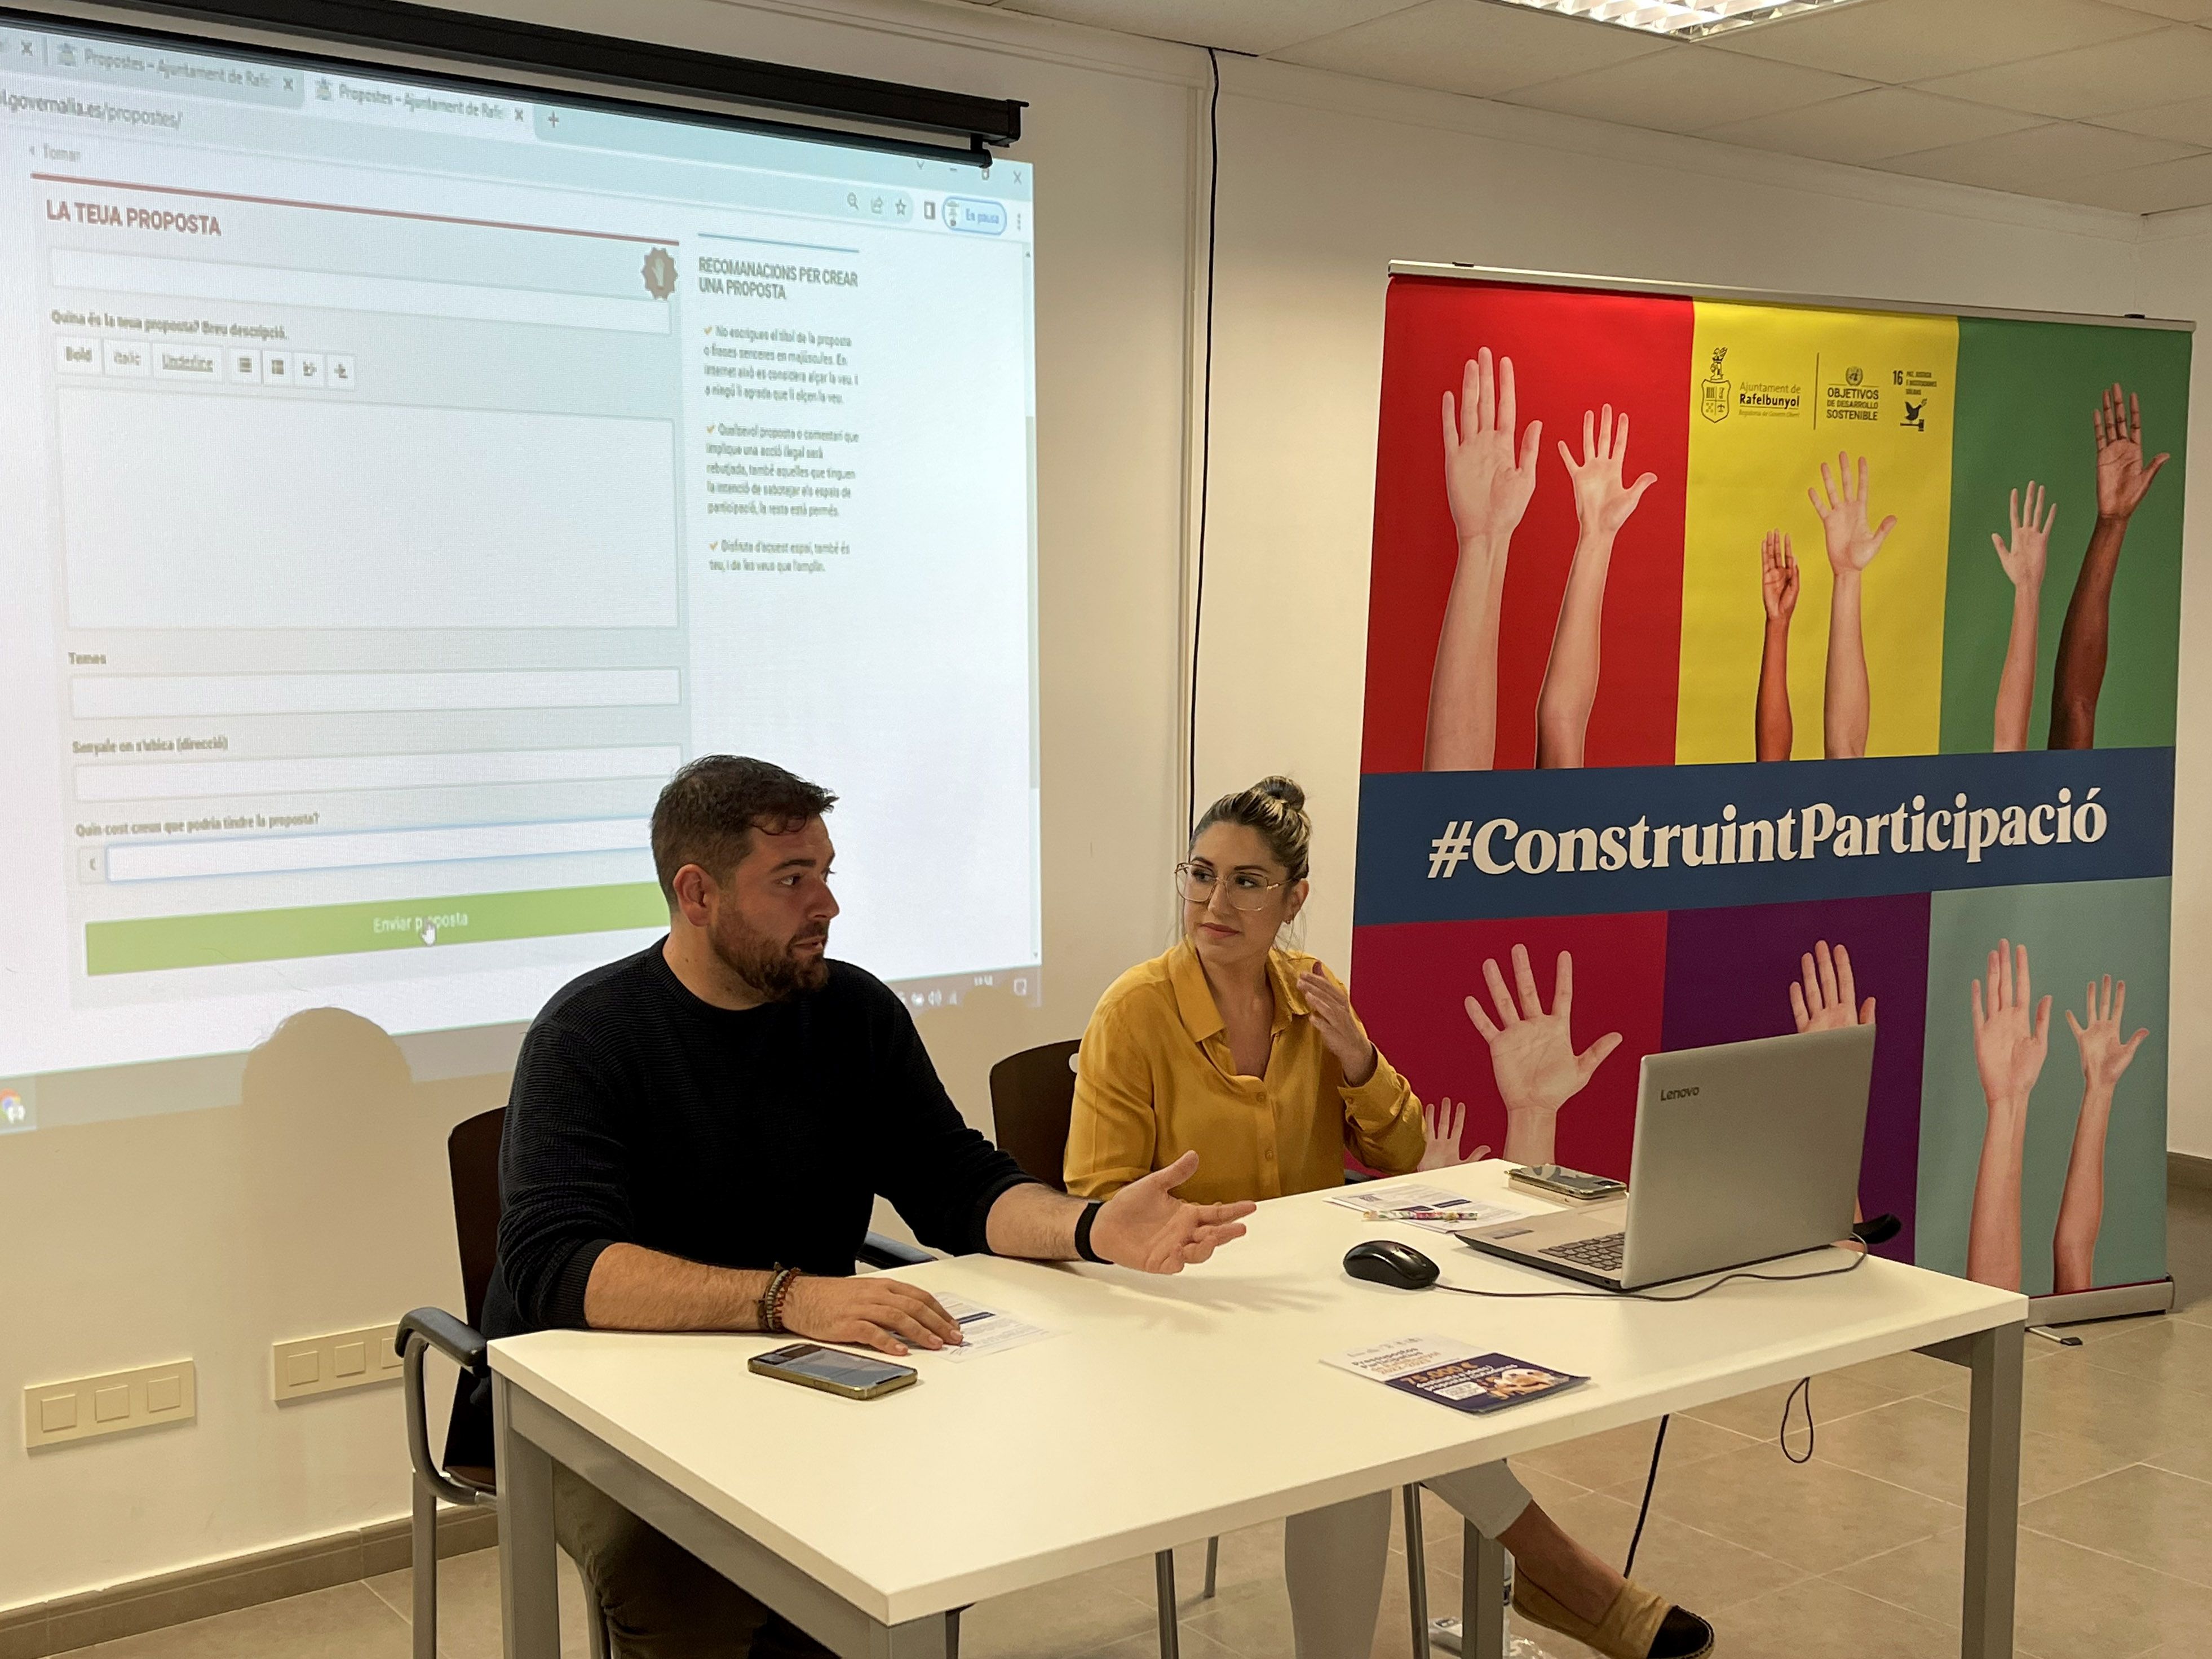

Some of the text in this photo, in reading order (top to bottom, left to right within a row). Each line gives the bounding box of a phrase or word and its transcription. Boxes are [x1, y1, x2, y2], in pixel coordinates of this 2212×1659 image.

[47, 199, 221, 236] LA TEUA PROPOSTA
[966, 209, 999, 225] En pausa
[699, 256, 858, 287] RECOMANACIONS PER CREAR
[699, 277, 786, 300] UNA PROPOSTA
[51, 309, 86, 325] Quina
[716, 325, 728, 337] No
[797, 331, 806, 343] de
[808, 331, 815, 344] la
[817, 335, 852, 348] proposta
[66, 346, 92, 362] Bold
[704, 346, 709, 356] o
[777, 352, 786, 361] en
[837, 353, 848, 365] En
[1893, 370, 1903, 386] 16
[773, 390, 788, 401] que
[1740, 382, 1801, 394] Ajuntament de
[1828, 387, 1878, 400] OBJETIVOS
[1740, 393, 1800, 409] Rafelbunyol
[1837, 400, 1878, 409] DESARROLLO
[1826, 409, 1878, 421] SOSTENIBLE
[760, 427, 795, 440] proposta
[844, 432, 859, 444] que
[811, 469, 825, 479] que
[751, 484, 760, 495] de
[842, 486, 851, 498] de
[76, 823, 101, 837] Quin
[164, 822, 184, 835] que
[269, 811, 320, 829] proposta?
[1427, 788, 2108, 879] #ConstruintParticipació
[373, 915, 412, 933] Enviar
[1661, 1086, 1700, 1101] Lenovo
